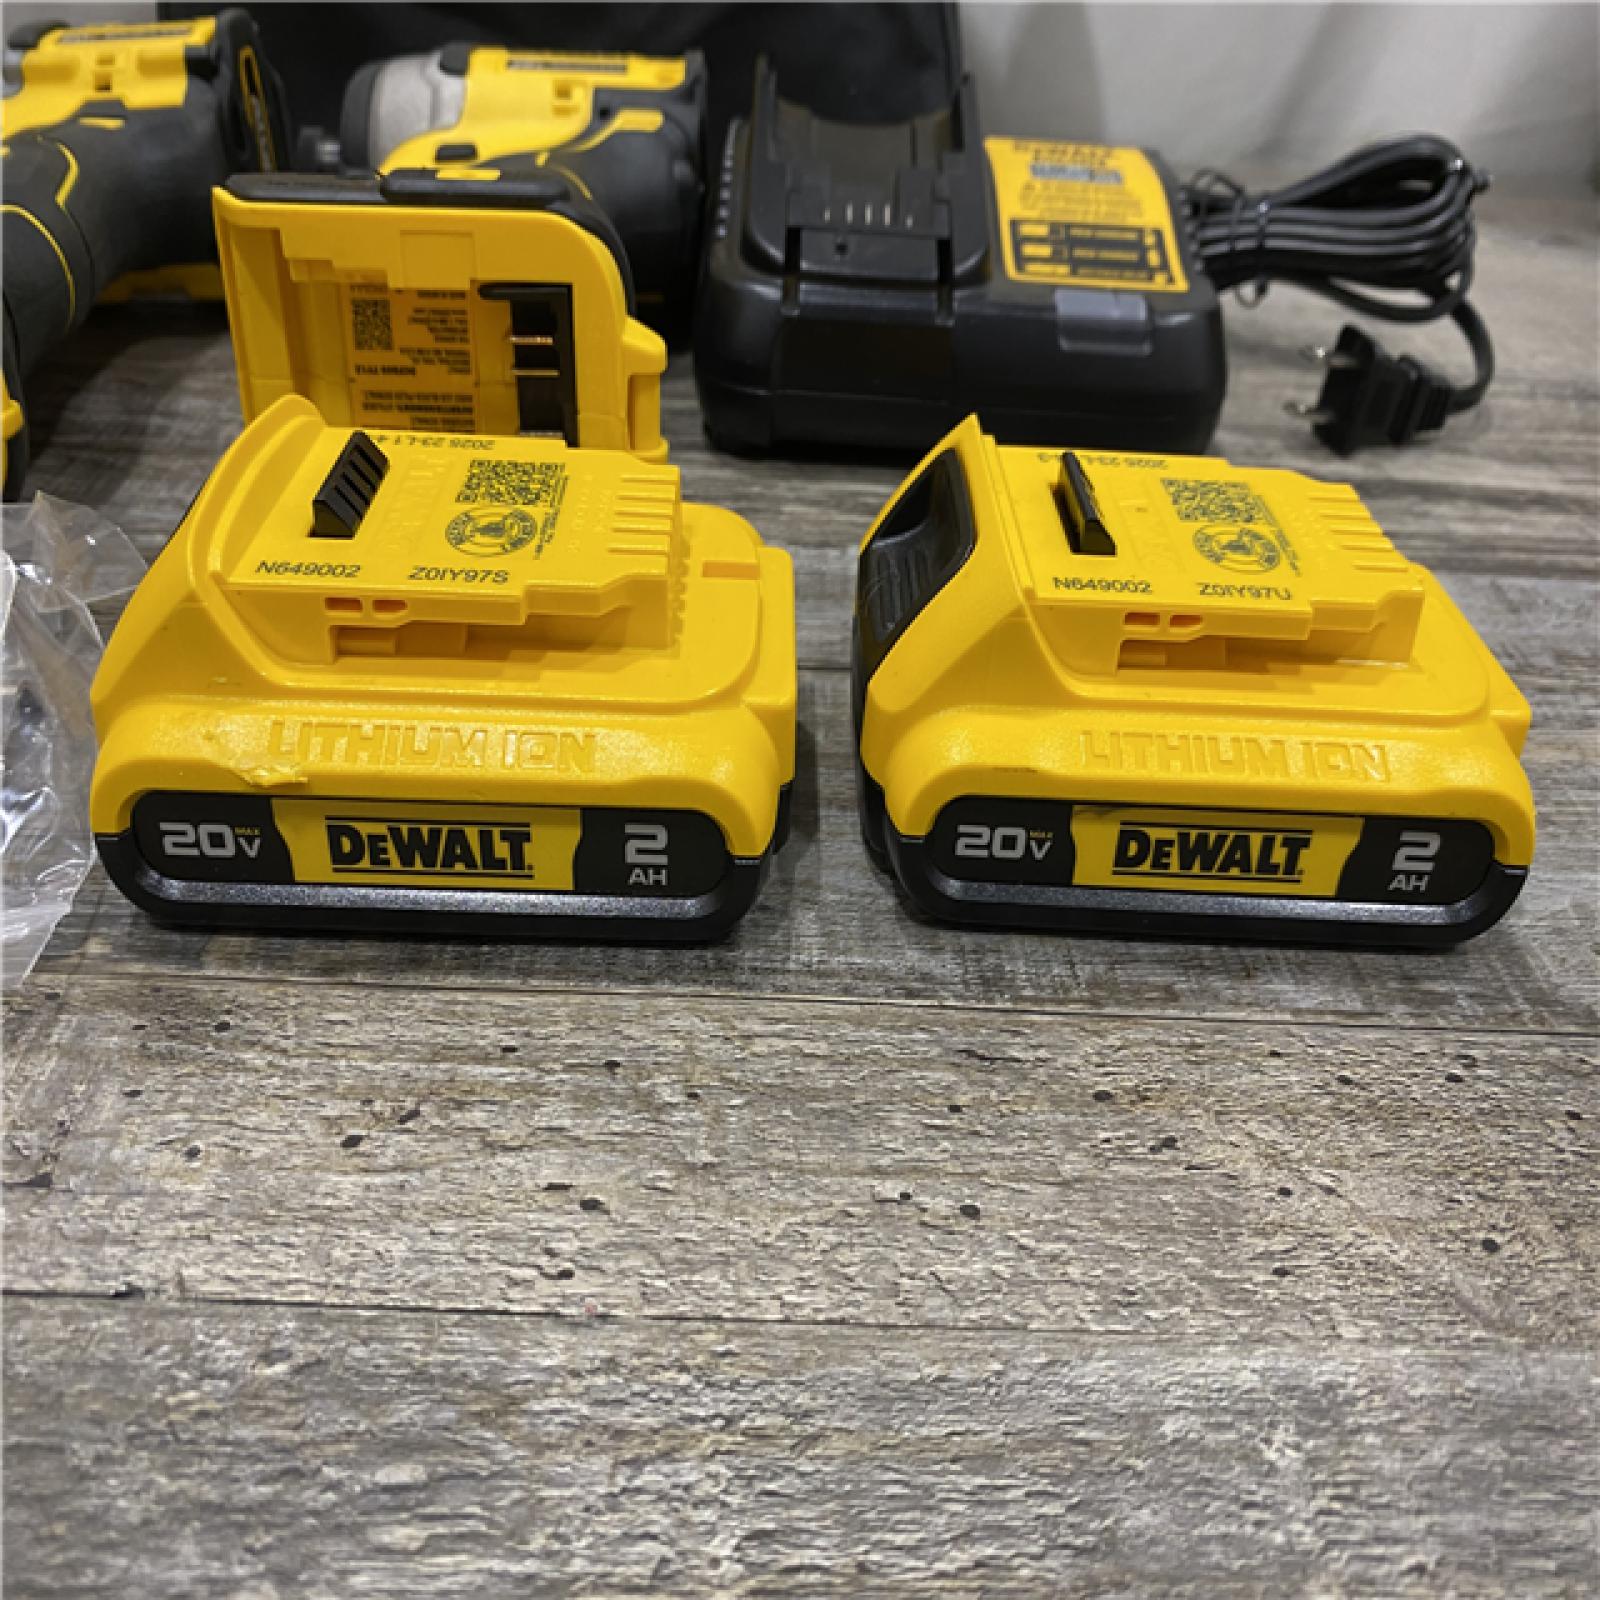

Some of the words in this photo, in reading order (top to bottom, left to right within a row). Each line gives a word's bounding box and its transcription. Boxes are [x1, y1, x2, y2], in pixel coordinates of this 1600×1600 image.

[254, 560, 361, 578] N649002
[1052, 576, 1153, 594] N649002
[267, 718, 489, 772] LITHIUM
[503, 729, 597, 775] ION
[1079, 729, 1300, 781] LITHIUM
[1302, 737, 1392, 783] ION
[624, 824, 669, 865] 2
[1392, 832, 1441, 872] 2
[626, 868, 668, 887] AH
[1387, 876, 1429, 893] AH
